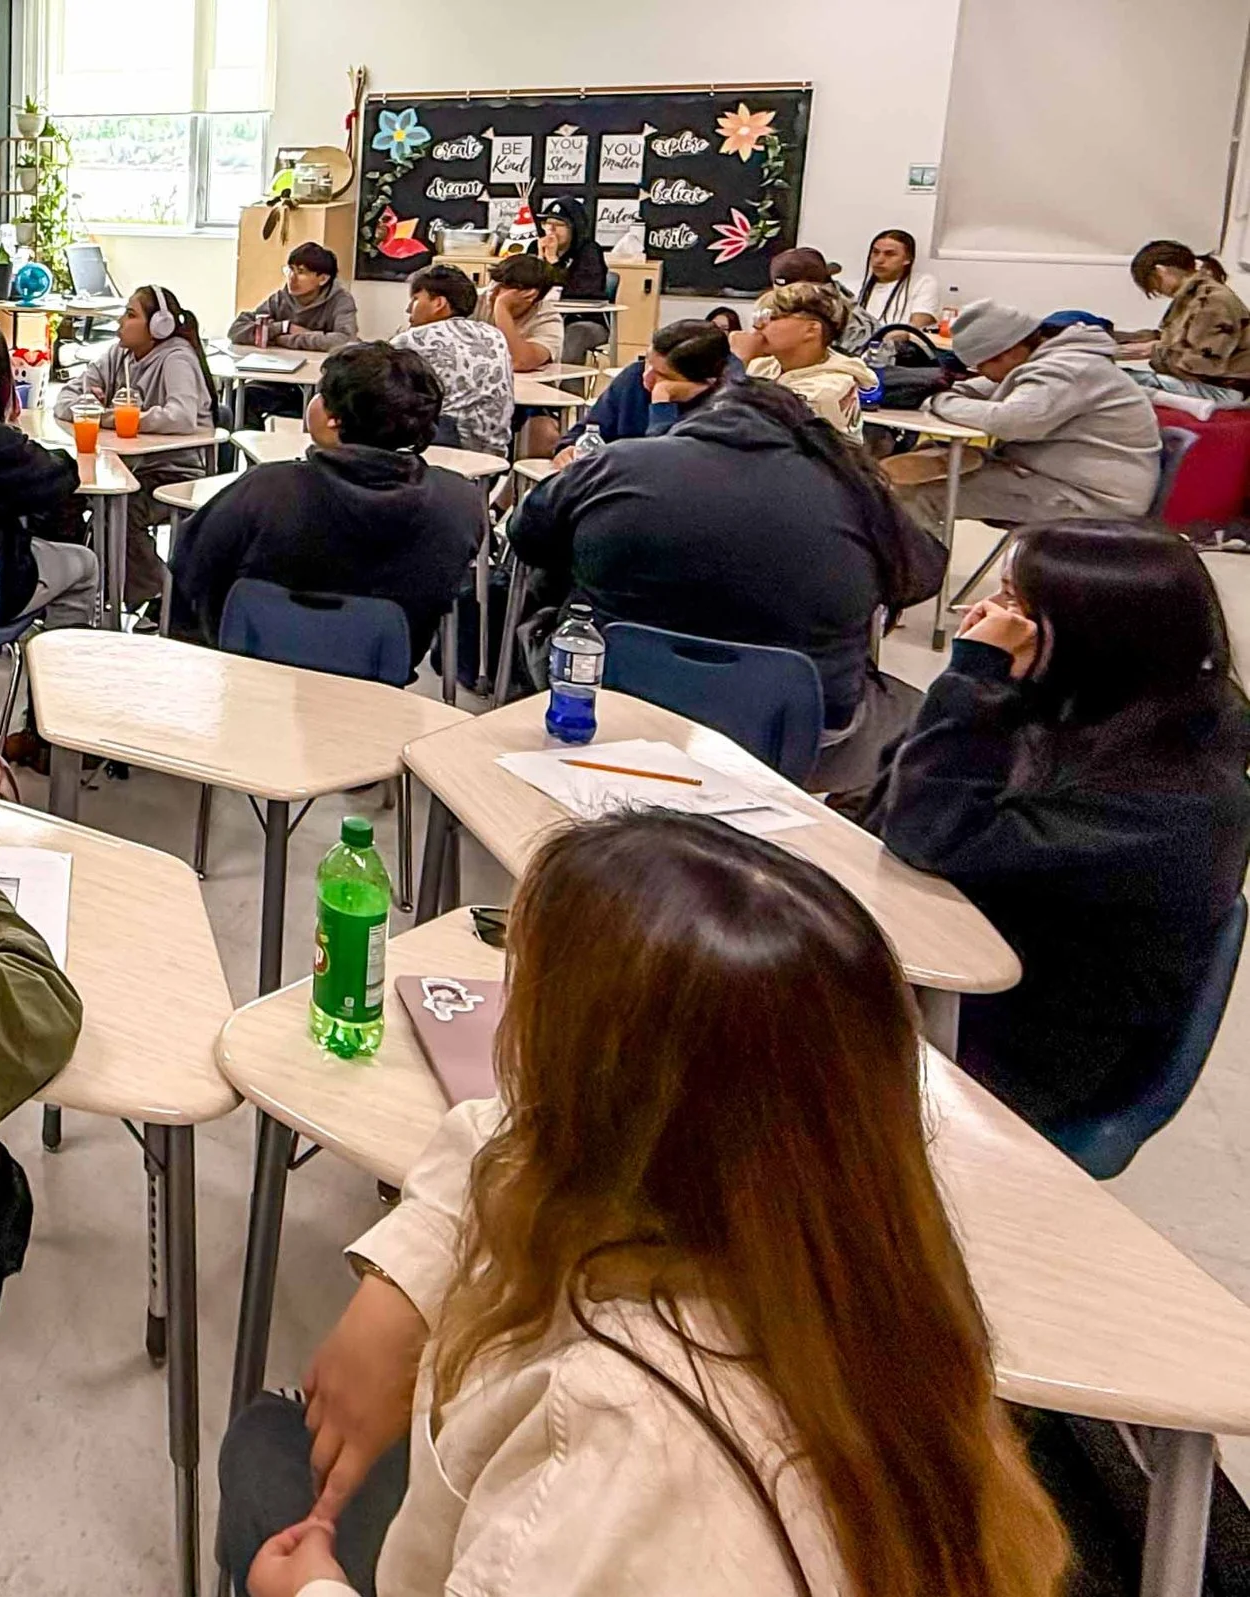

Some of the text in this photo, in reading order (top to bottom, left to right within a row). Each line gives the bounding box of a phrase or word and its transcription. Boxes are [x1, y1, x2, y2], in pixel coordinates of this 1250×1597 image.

[433, 136, 484, 160] create
[502, 142, 522, 155] BE
[551, 138, 583, 150] YOU
[604, 143, 641, 156] YOU
[652, 132, 710, 158] explore
[492, 154, 530, 174] Kind
[547, 156, 582, 176] Story
[426, 177, 484, 200] dream
[649, 223, 698, 248] write
